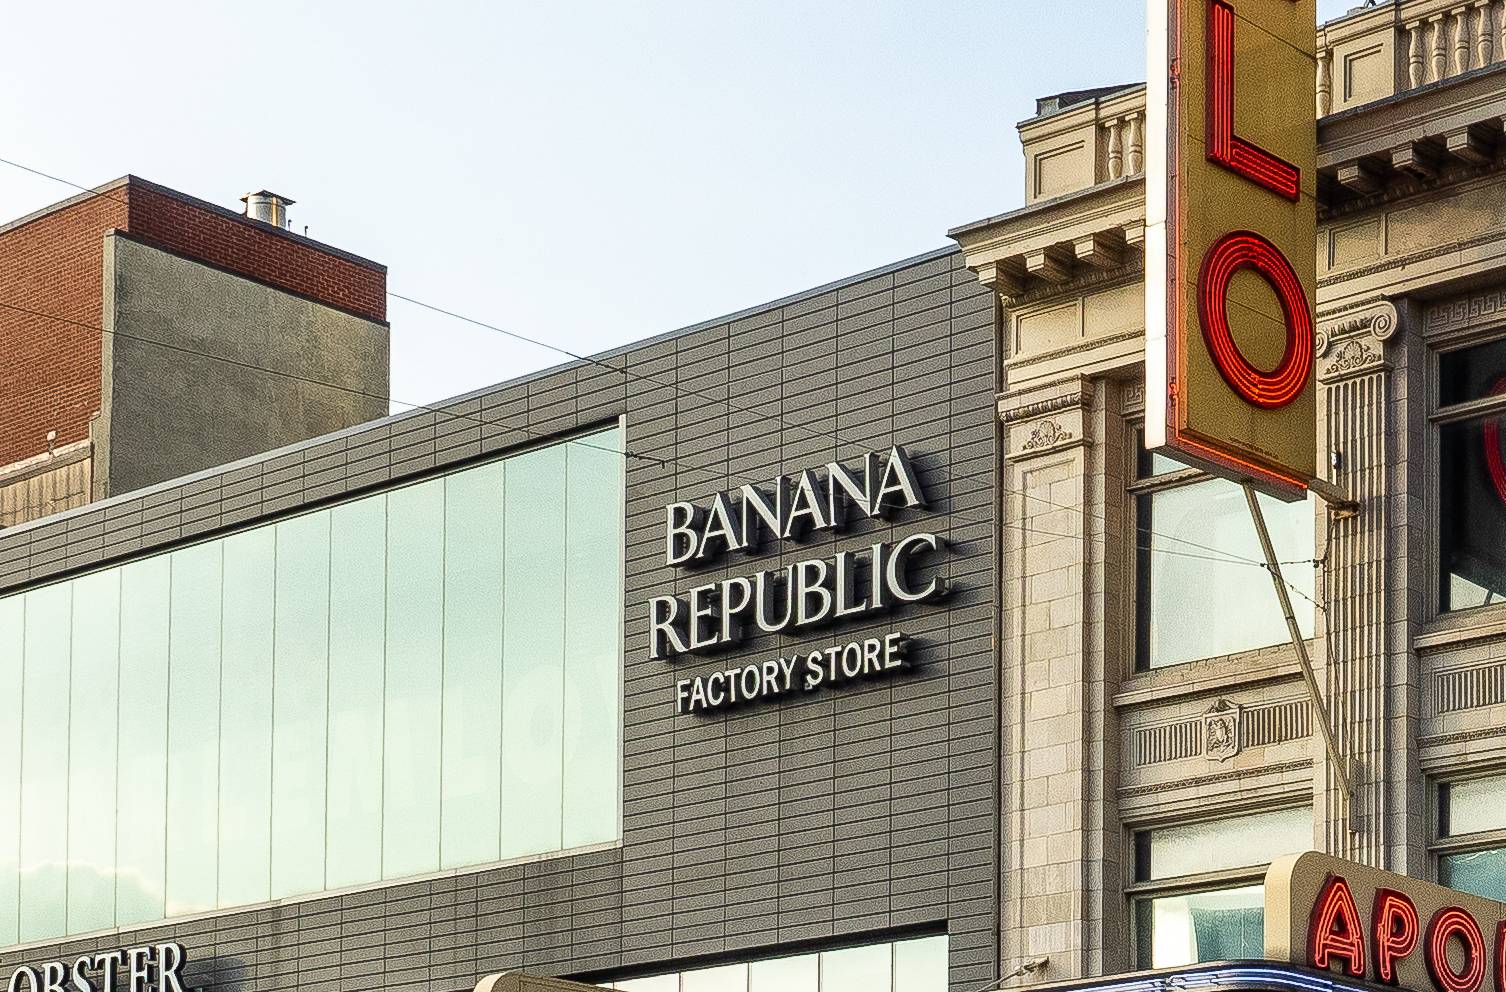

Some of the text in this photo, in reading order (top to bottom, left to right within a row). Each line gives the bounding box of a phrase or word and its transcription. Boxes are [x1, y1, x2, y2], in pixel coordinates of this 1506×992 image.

[665, 445, 924, 566] BANANA
[648, 532, 943, 660] REPUBLIC
[676, 632, 905, 713] FACTORY STORE
